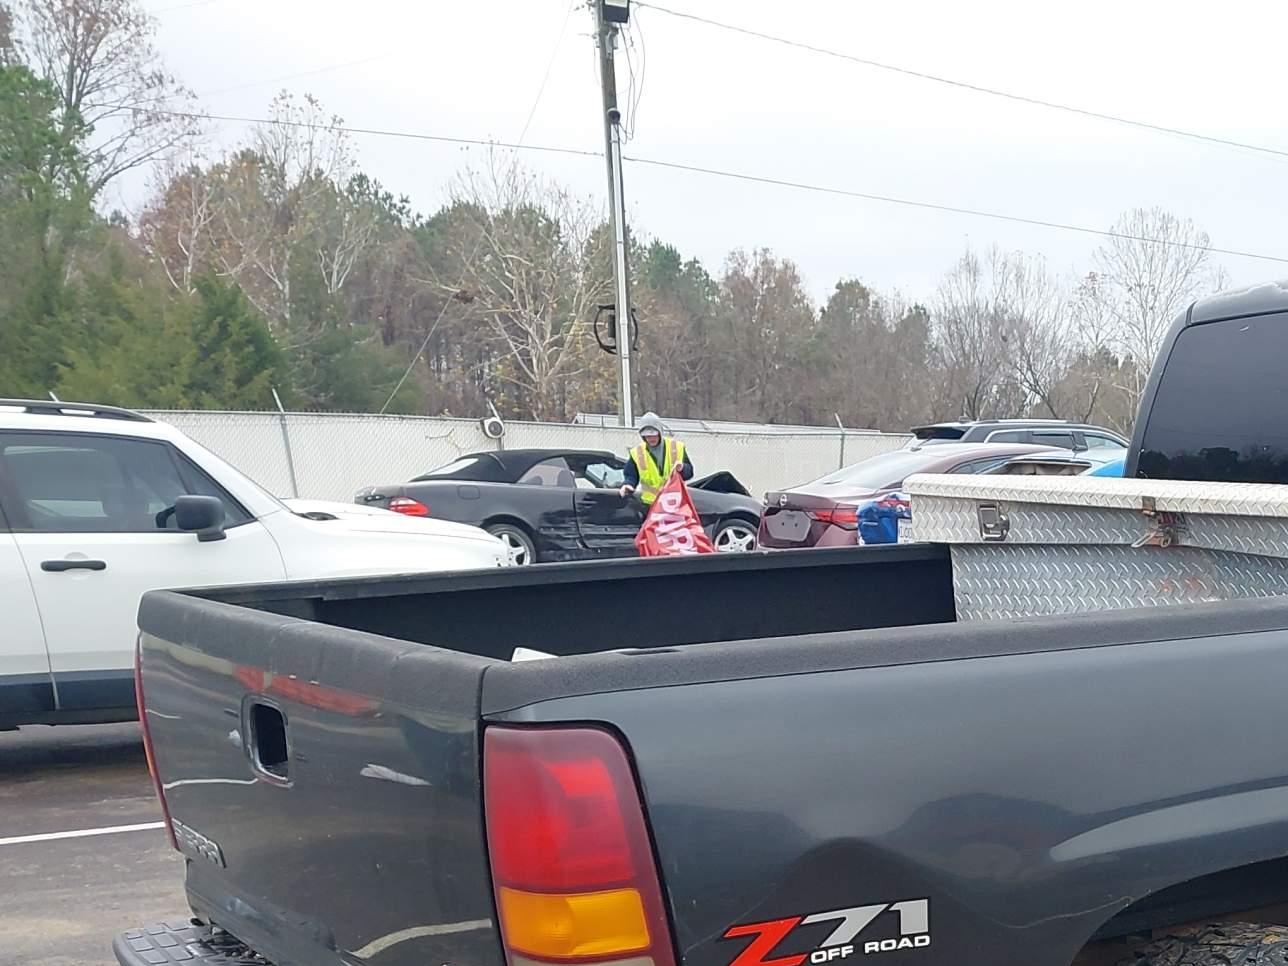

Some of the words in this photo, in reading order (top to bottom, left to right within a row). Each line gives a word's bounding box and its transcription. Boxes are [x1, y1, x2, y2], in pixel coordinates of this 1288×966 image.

[650, 491, 698, 554] PAR
[810, 944, 854, 965] OFF
[864, 934, 931, 955] ROAD
